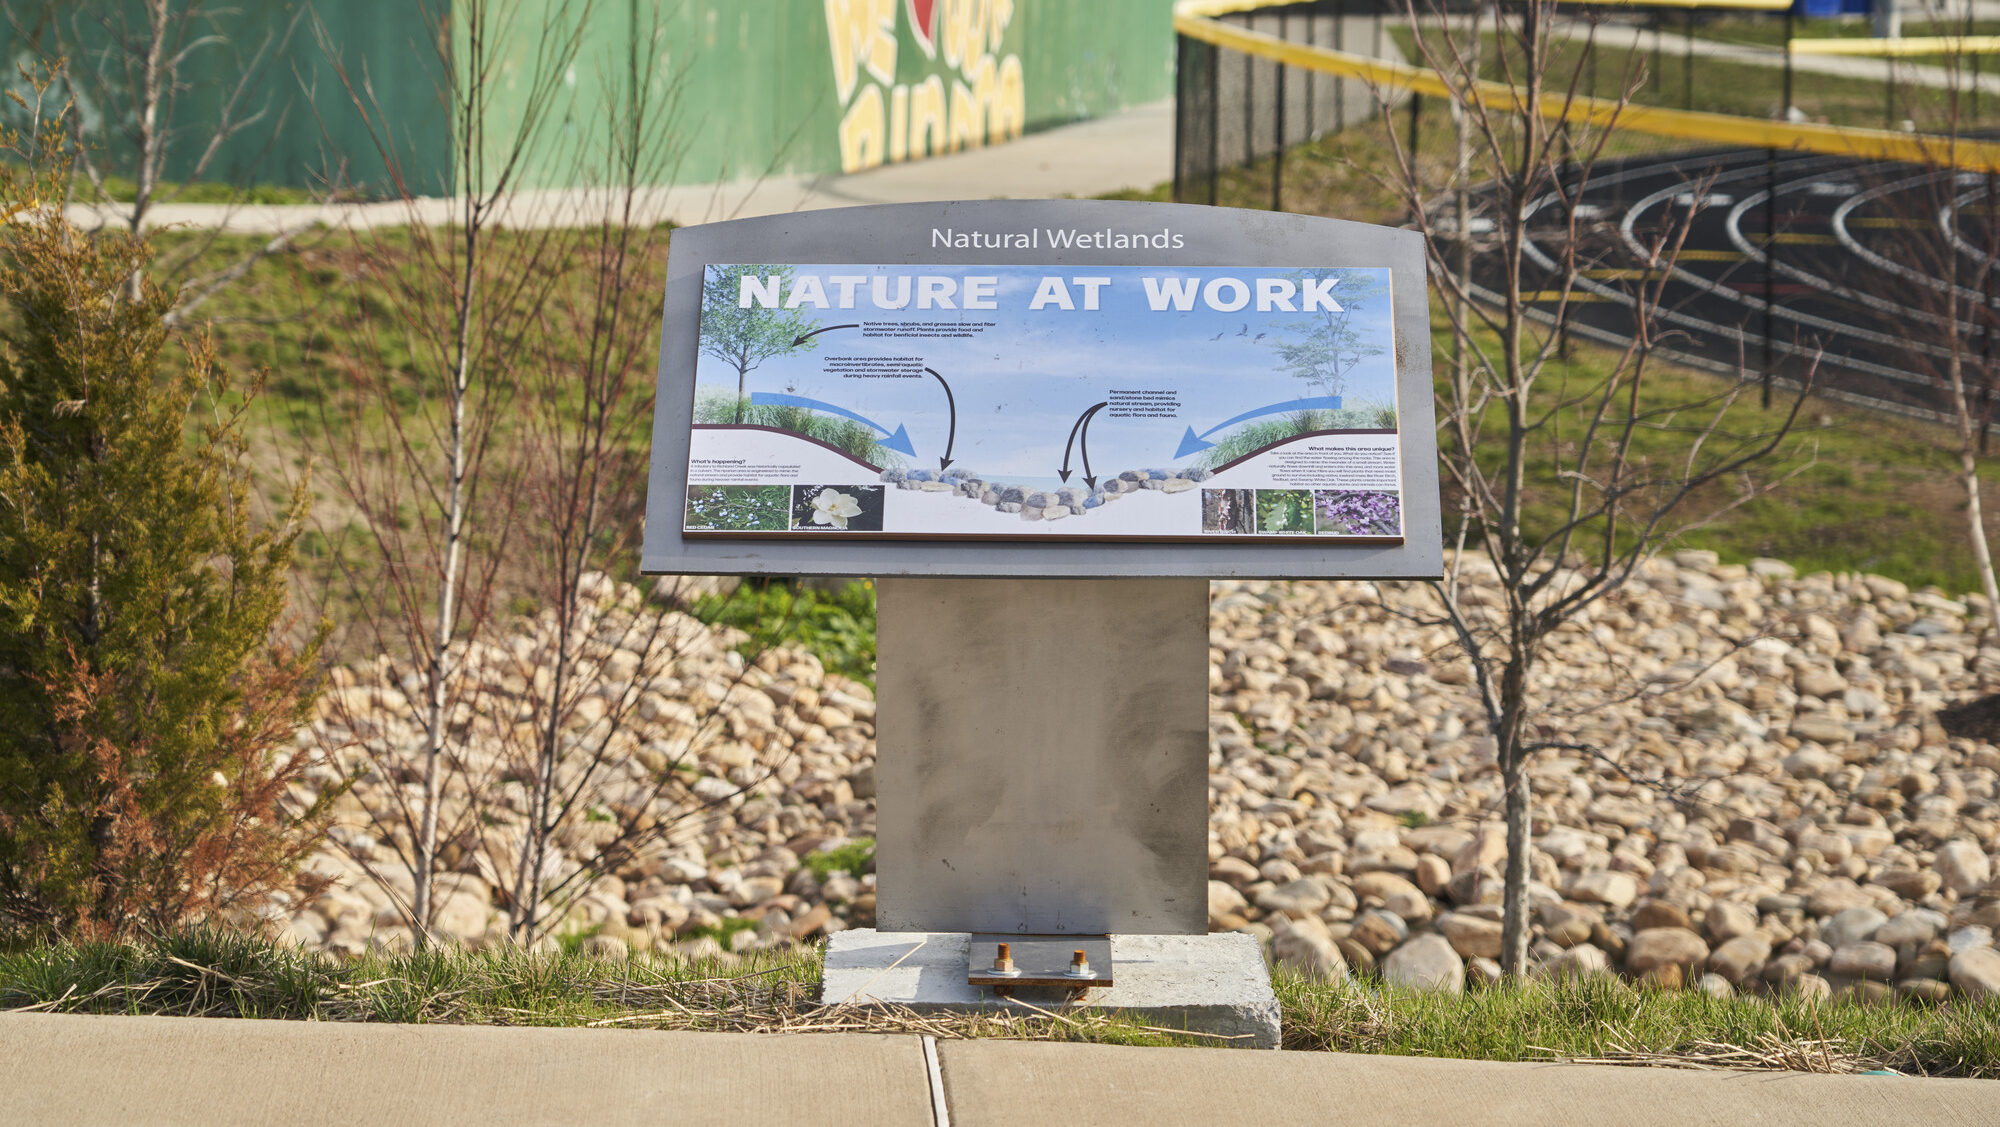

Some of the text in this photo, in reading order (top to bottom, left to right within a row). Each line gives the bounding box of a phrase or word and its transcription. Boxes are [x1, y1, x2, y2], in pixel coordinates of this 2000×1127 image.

[931, 228, 1185, 249] Natural Wetlands
[739, 275, 1345, 312] NATURE AT WORK
